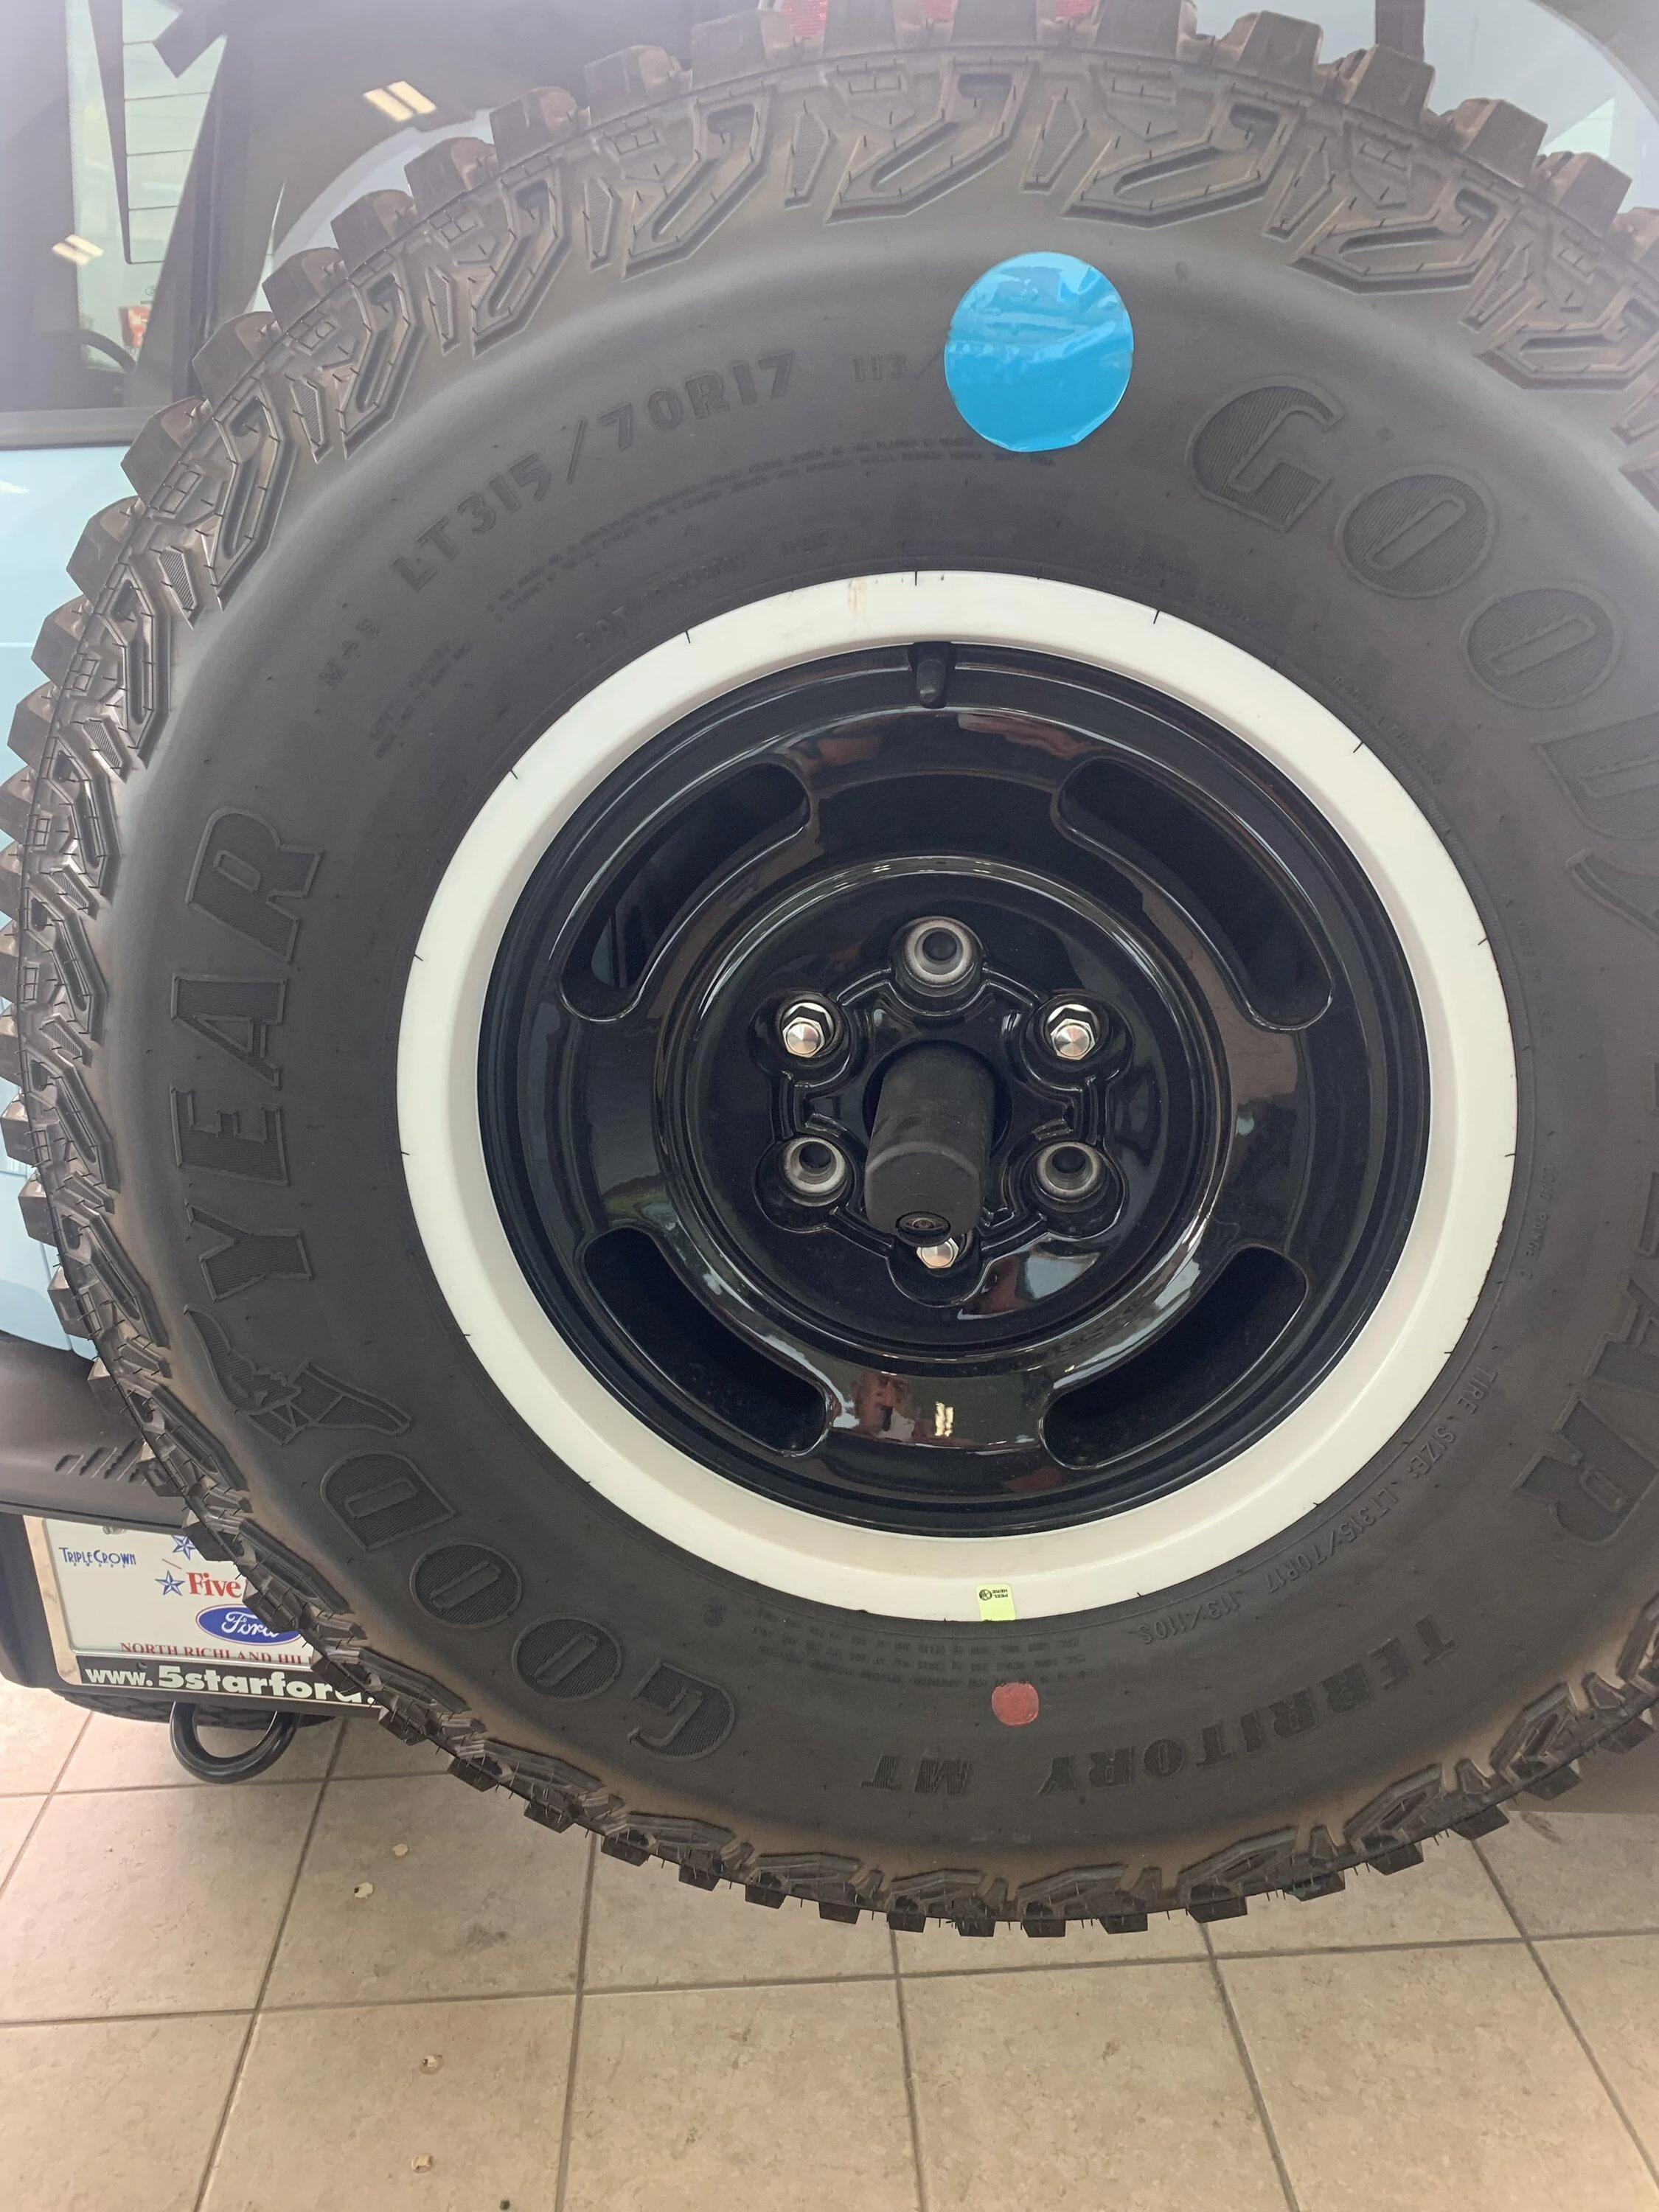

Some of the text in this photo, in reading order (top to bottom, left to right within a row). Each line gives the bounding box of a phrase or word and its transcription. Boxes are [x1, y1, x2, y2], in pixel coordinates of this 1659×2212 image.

[389, 348, 796, 593] LT315/70R17
[1455, 1366, 1498, 1416] TIRE
[1265, 1485, 1401, 1594] LT315/70R17
[187, 1571, 242, 1599] Five
[120, 1642, 178, 1656] NORTH
[84, 1665, 375, 1705] www.5starfor.
[1038, 1614, 1461, 1795] TERRITORY
[860, 1753, 973, 1797] MT
